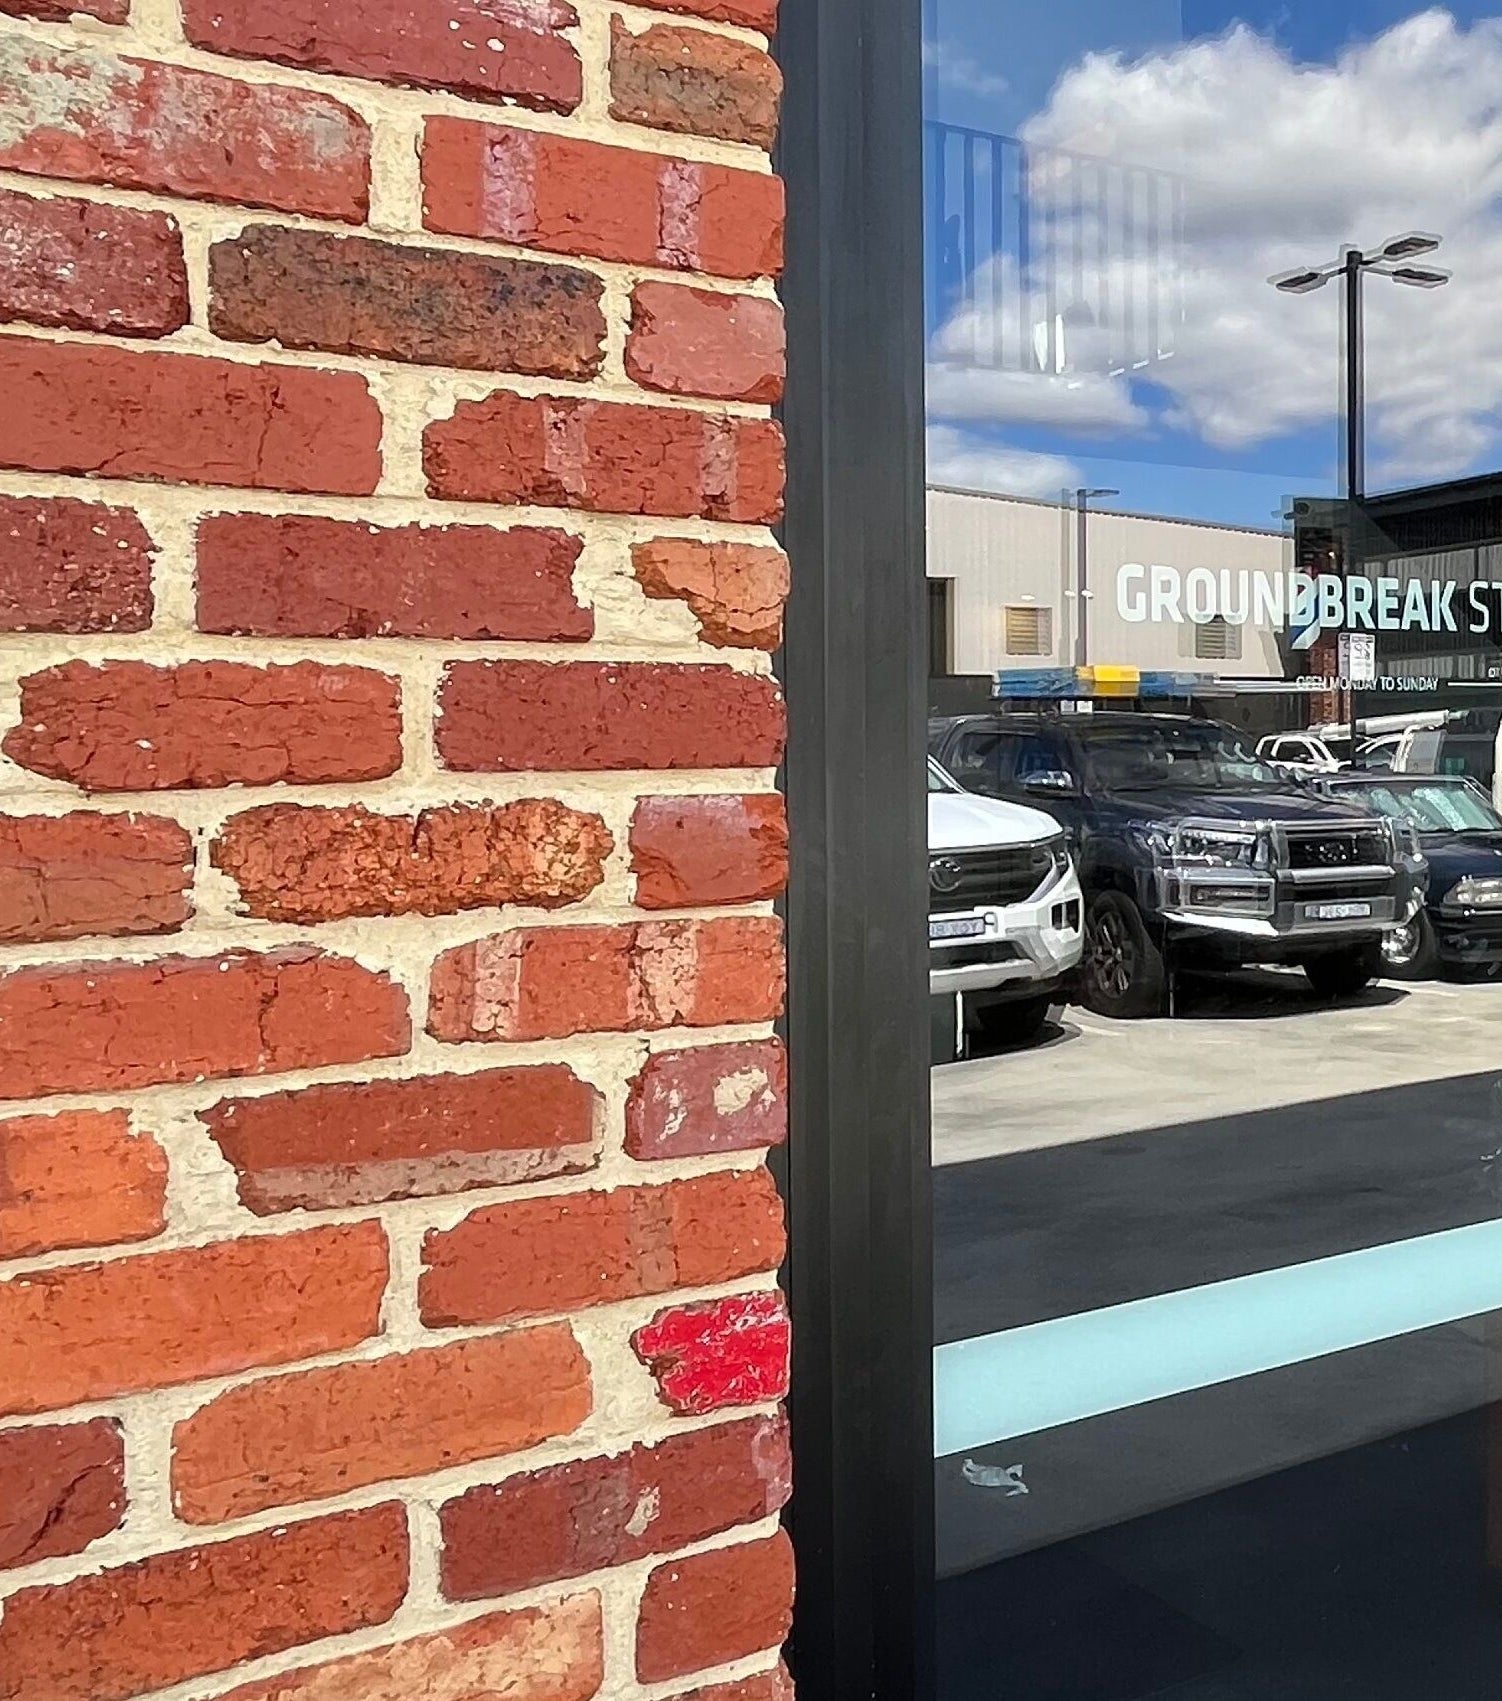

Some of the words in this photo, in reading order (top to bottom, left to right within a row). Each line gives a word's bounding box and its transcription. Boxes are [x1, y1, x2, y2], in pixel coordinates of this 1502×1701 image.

[1117, 563, 1458, 648] GROUNDBREAK
[1328, 676, 1377, 691] MONDAY
[1380, 676, 1395, 691] TO
[1397, 677, 1439, 691] SUNDAY
